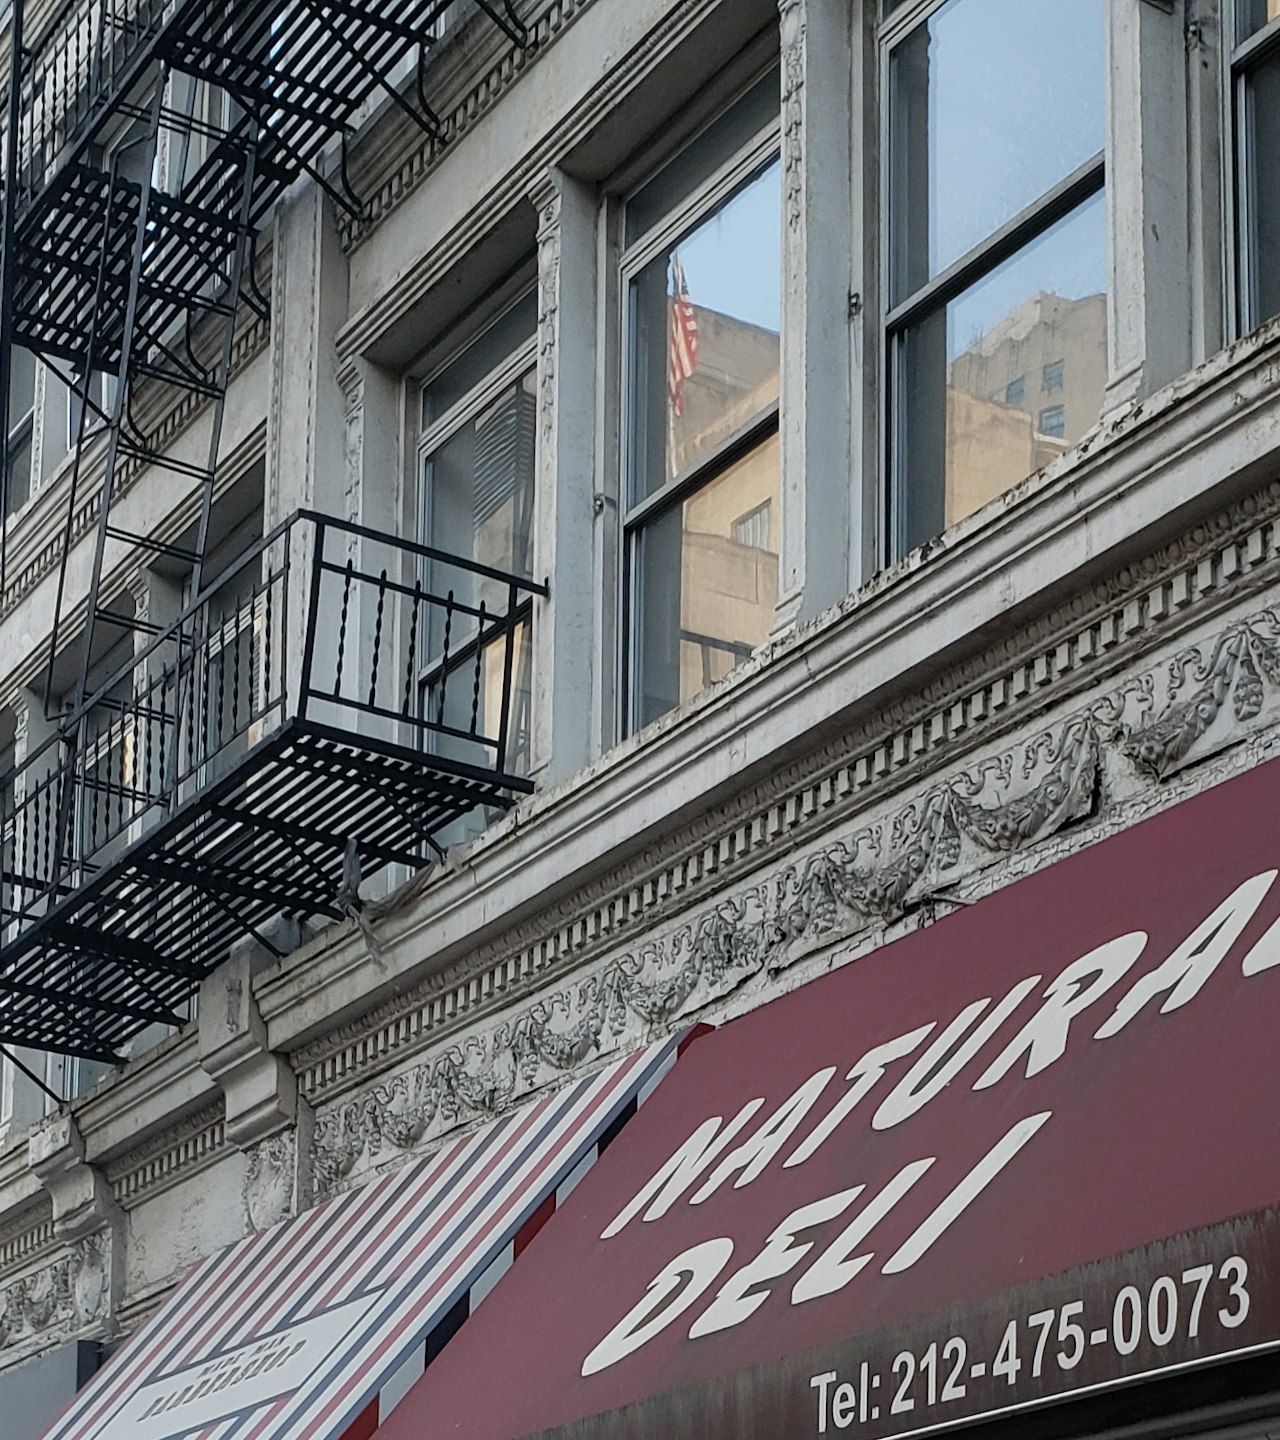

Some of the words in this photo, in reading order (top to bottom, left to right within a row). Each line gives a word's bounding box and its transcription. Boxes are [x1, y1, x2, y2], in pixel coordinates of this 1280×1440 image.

[581, 1110, 1052, 1376] DELI
[136, 1339, 307, 1423] BARBERSHOP
[810, 1362, 881, 1432] Tel:
[891, 1255, 1250, 1416] 212-475-0073
